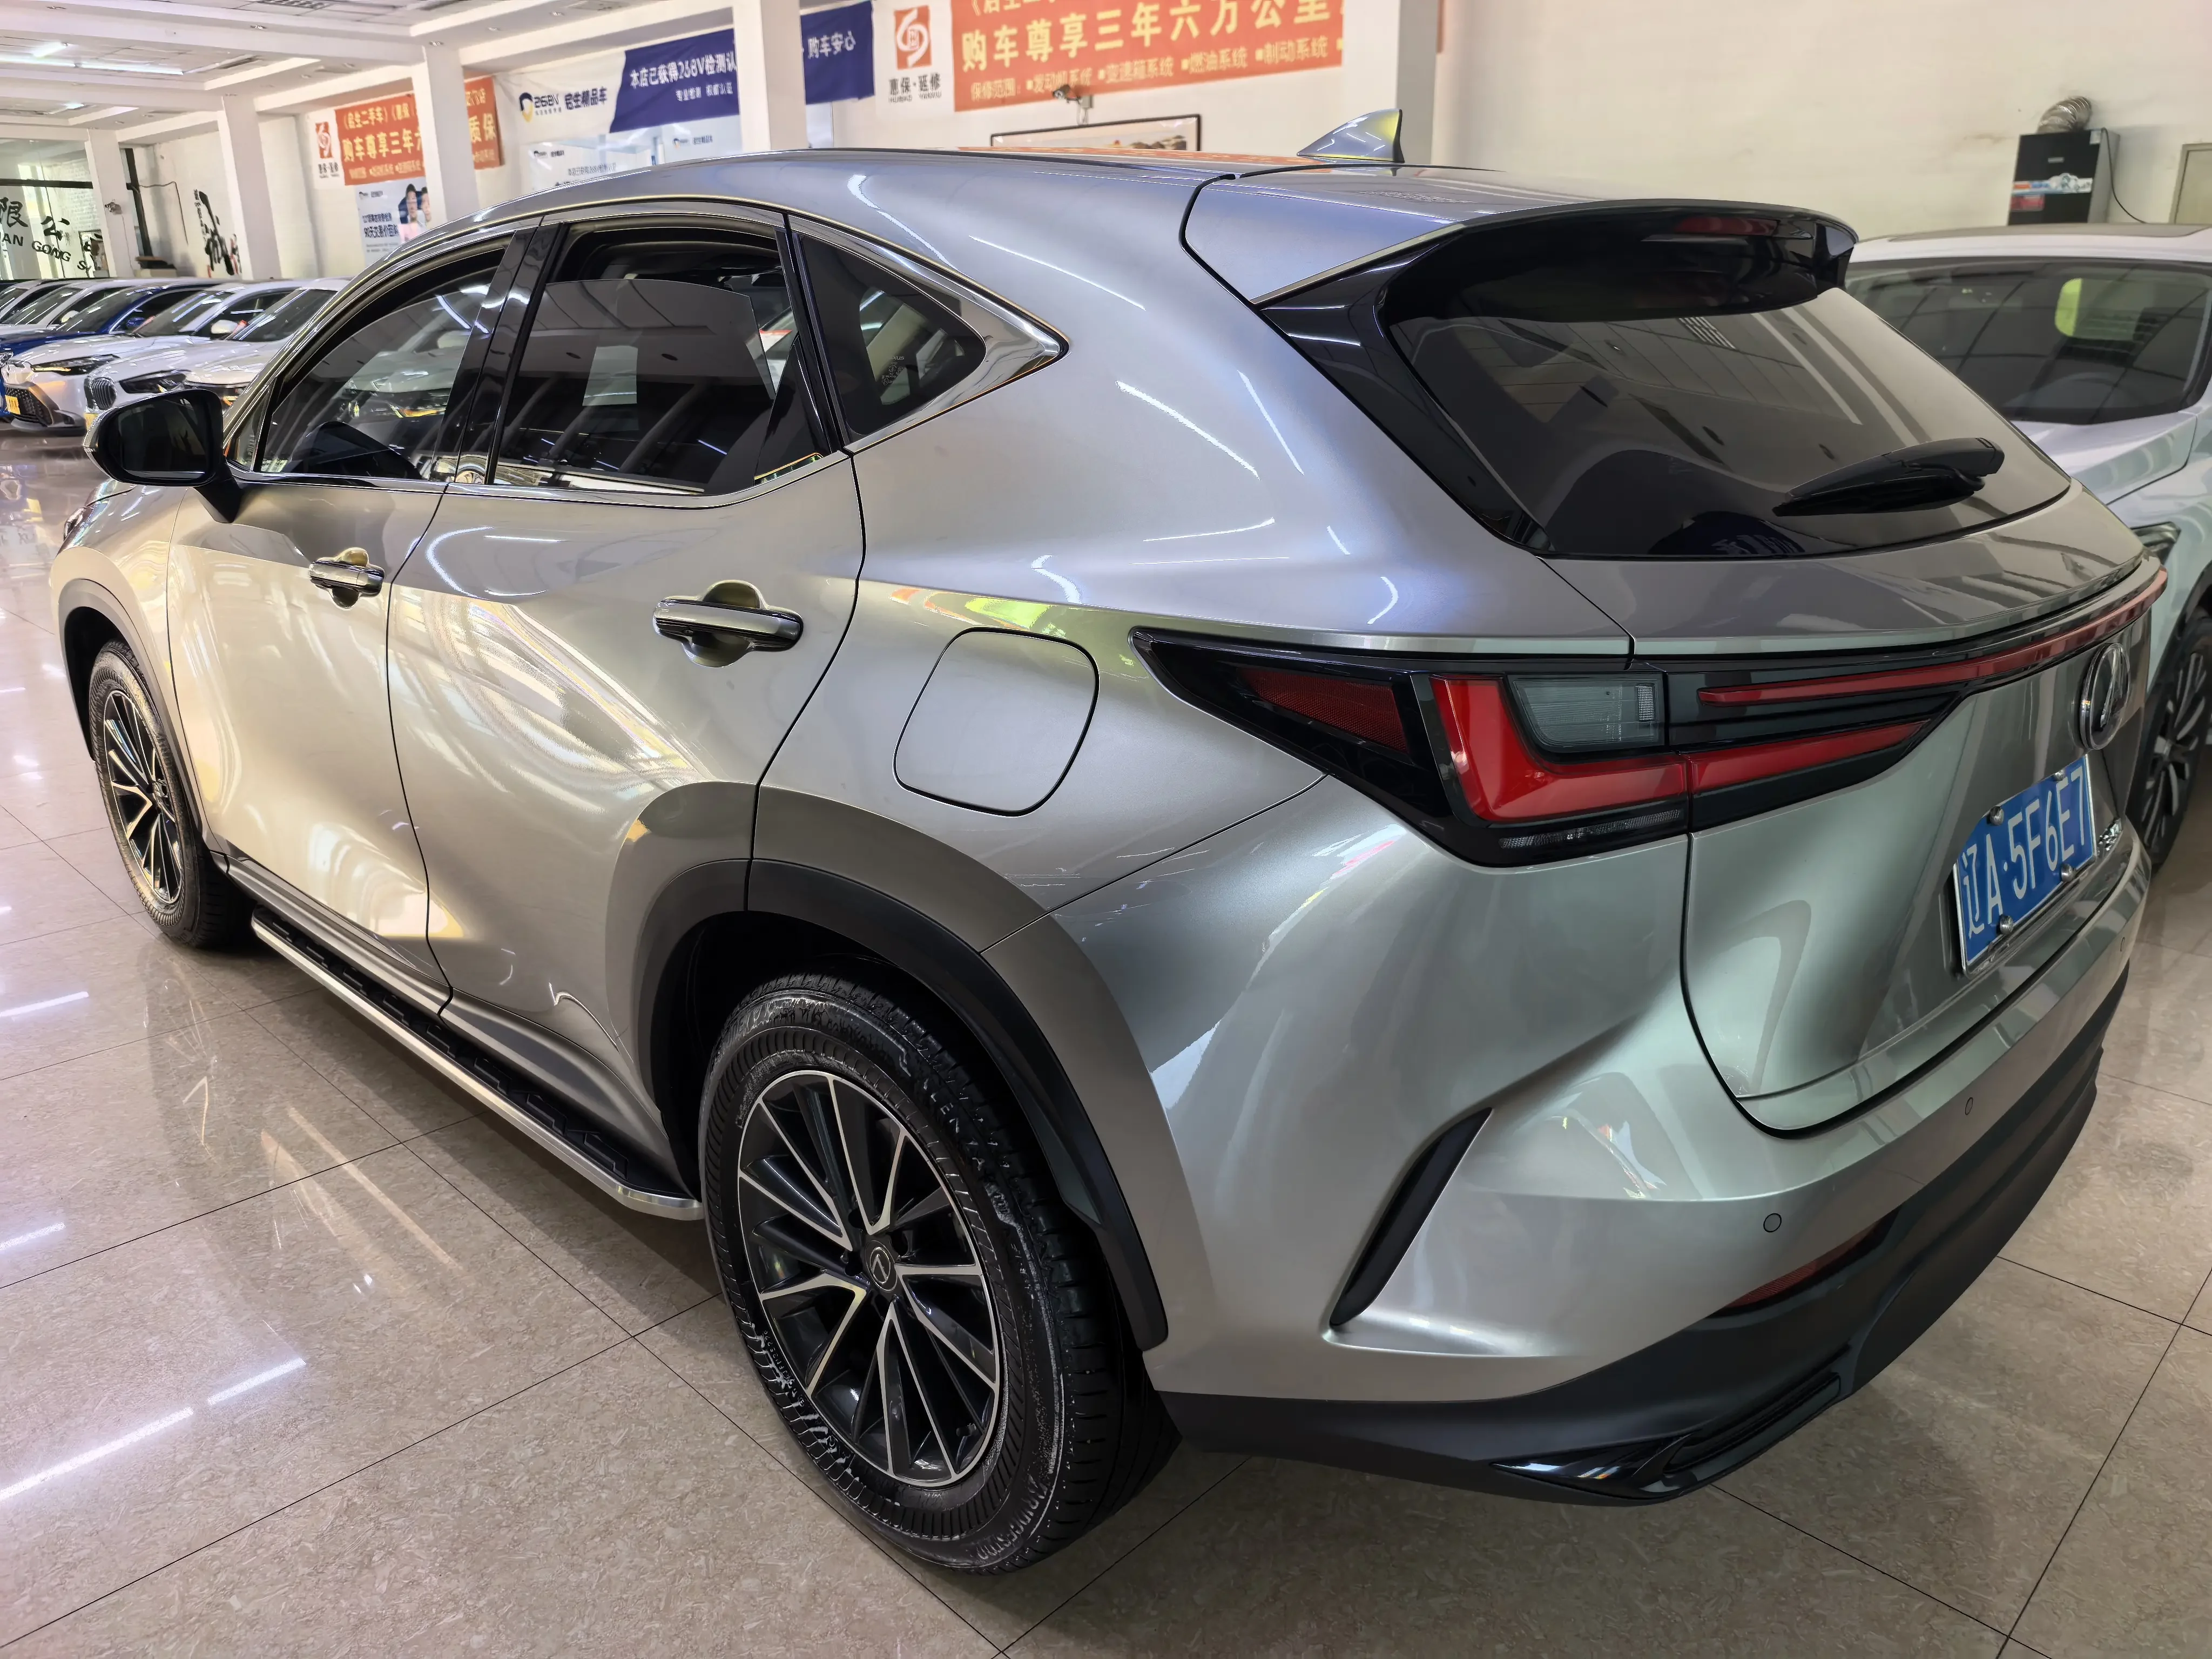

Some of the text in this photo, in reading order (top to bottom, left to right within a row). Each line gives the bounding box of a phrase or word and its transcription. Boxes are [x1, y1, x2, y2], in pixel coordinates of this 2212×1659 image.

[807, 30, 857, 59] 购车安心
[32, 240, 71, 262] GONG
